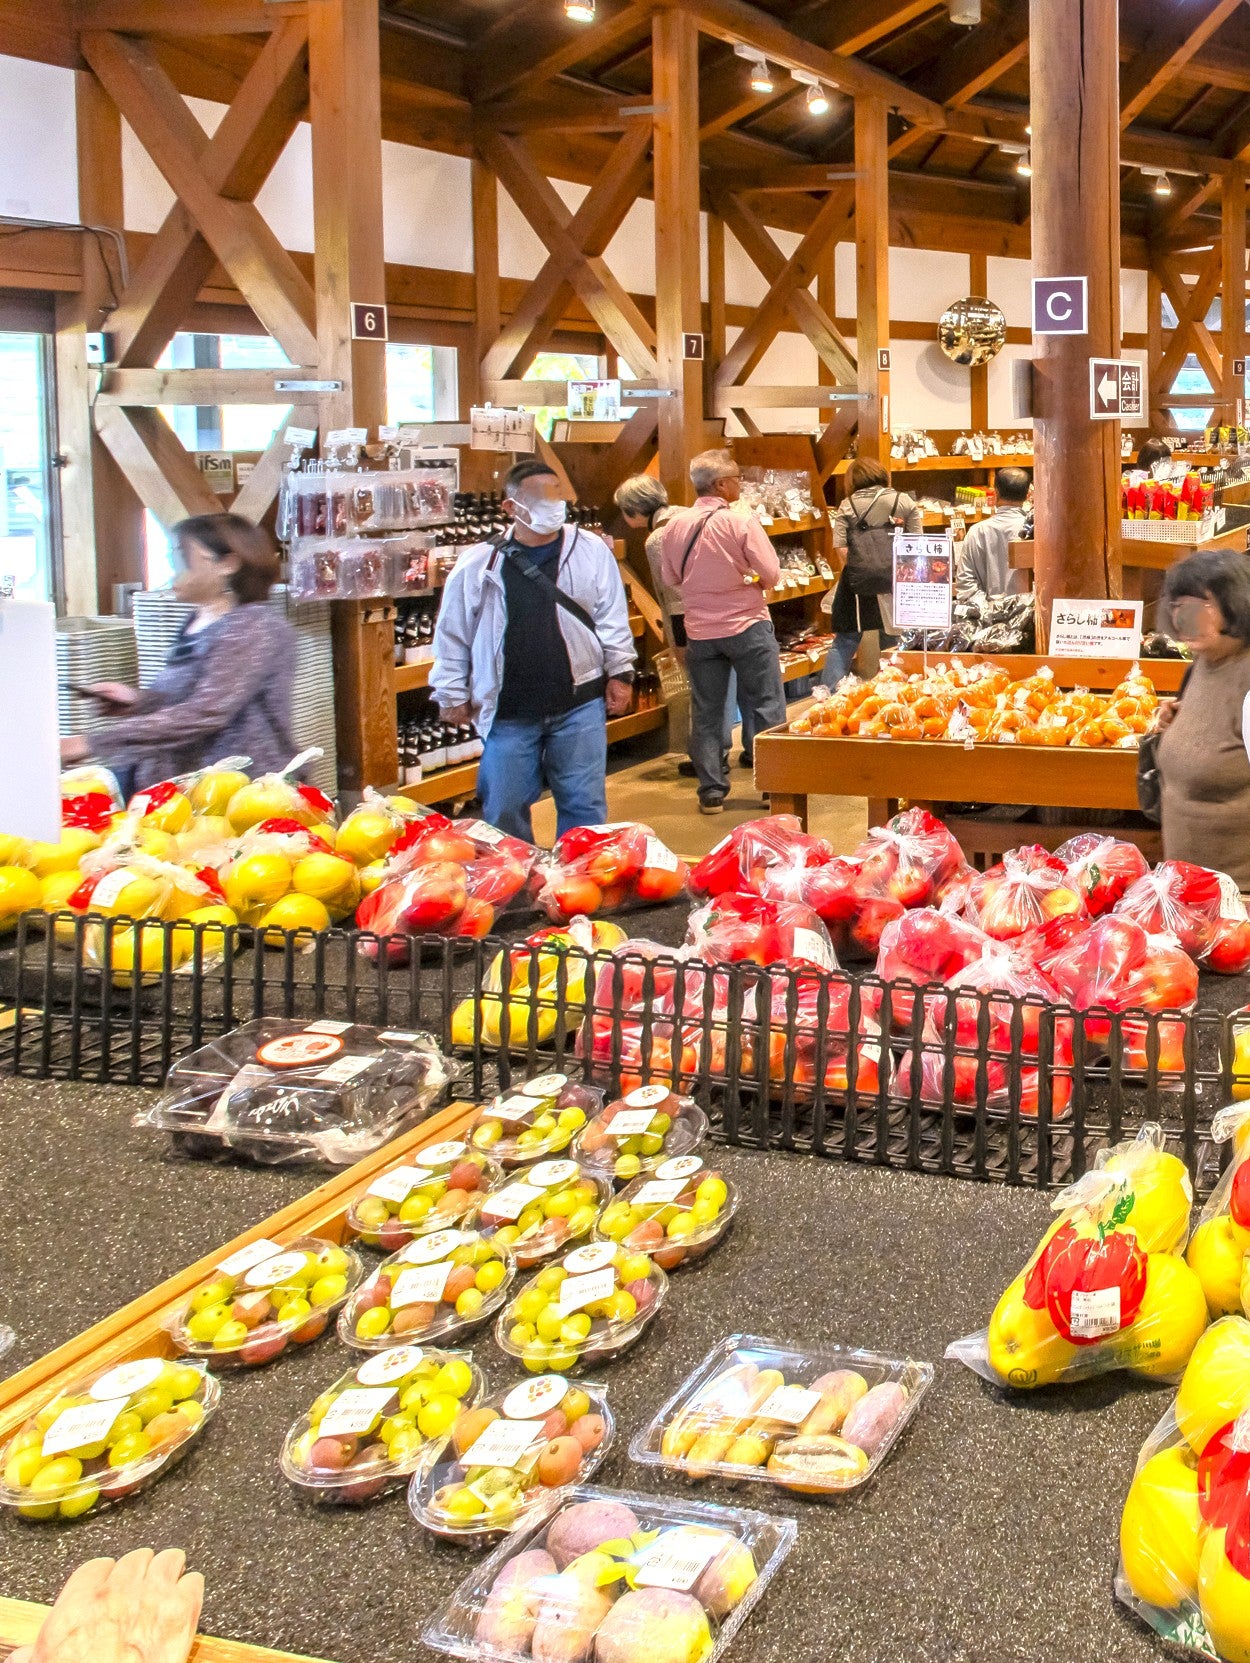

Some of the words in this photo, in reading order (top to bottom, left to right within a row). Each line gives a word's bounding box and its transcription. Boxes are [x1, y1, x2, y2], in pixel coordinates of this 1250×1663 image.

[1046, 291, 1073, 321] C
[364, 312, 376, 331] 6
[690, 339, 697, 354] 7
[882, 353, 888, 366] 8
[1122, 371, 1140, 392] 会計
[1121, 399, 1140, 412] Cashier
